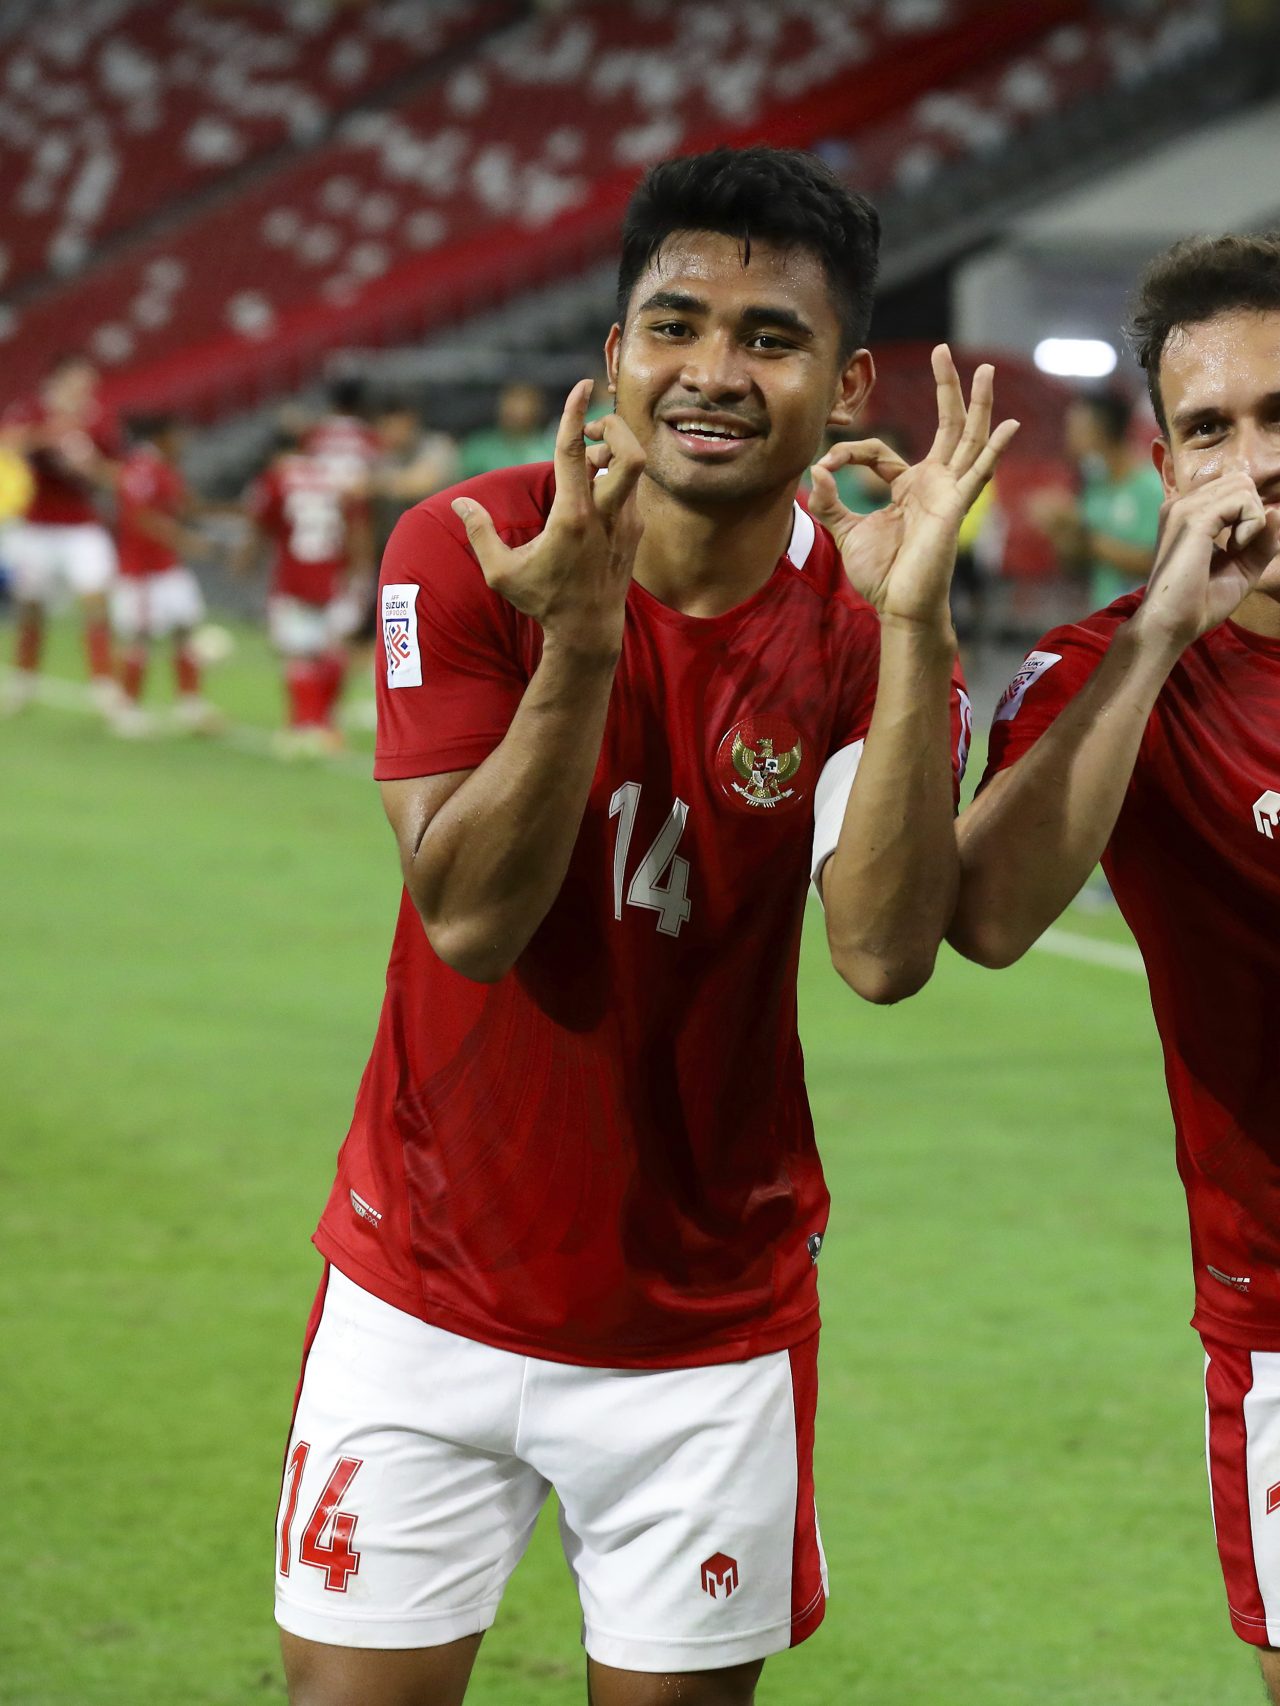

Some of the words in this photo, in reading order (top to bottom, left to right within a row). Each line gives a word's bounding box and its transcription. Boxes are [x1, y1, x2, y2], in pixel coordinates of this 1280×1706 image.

[385, 601, 409, 610] SUZUKI
[608, 780, 692, 938] 14
[279, 1440, 364, 1593] 14
